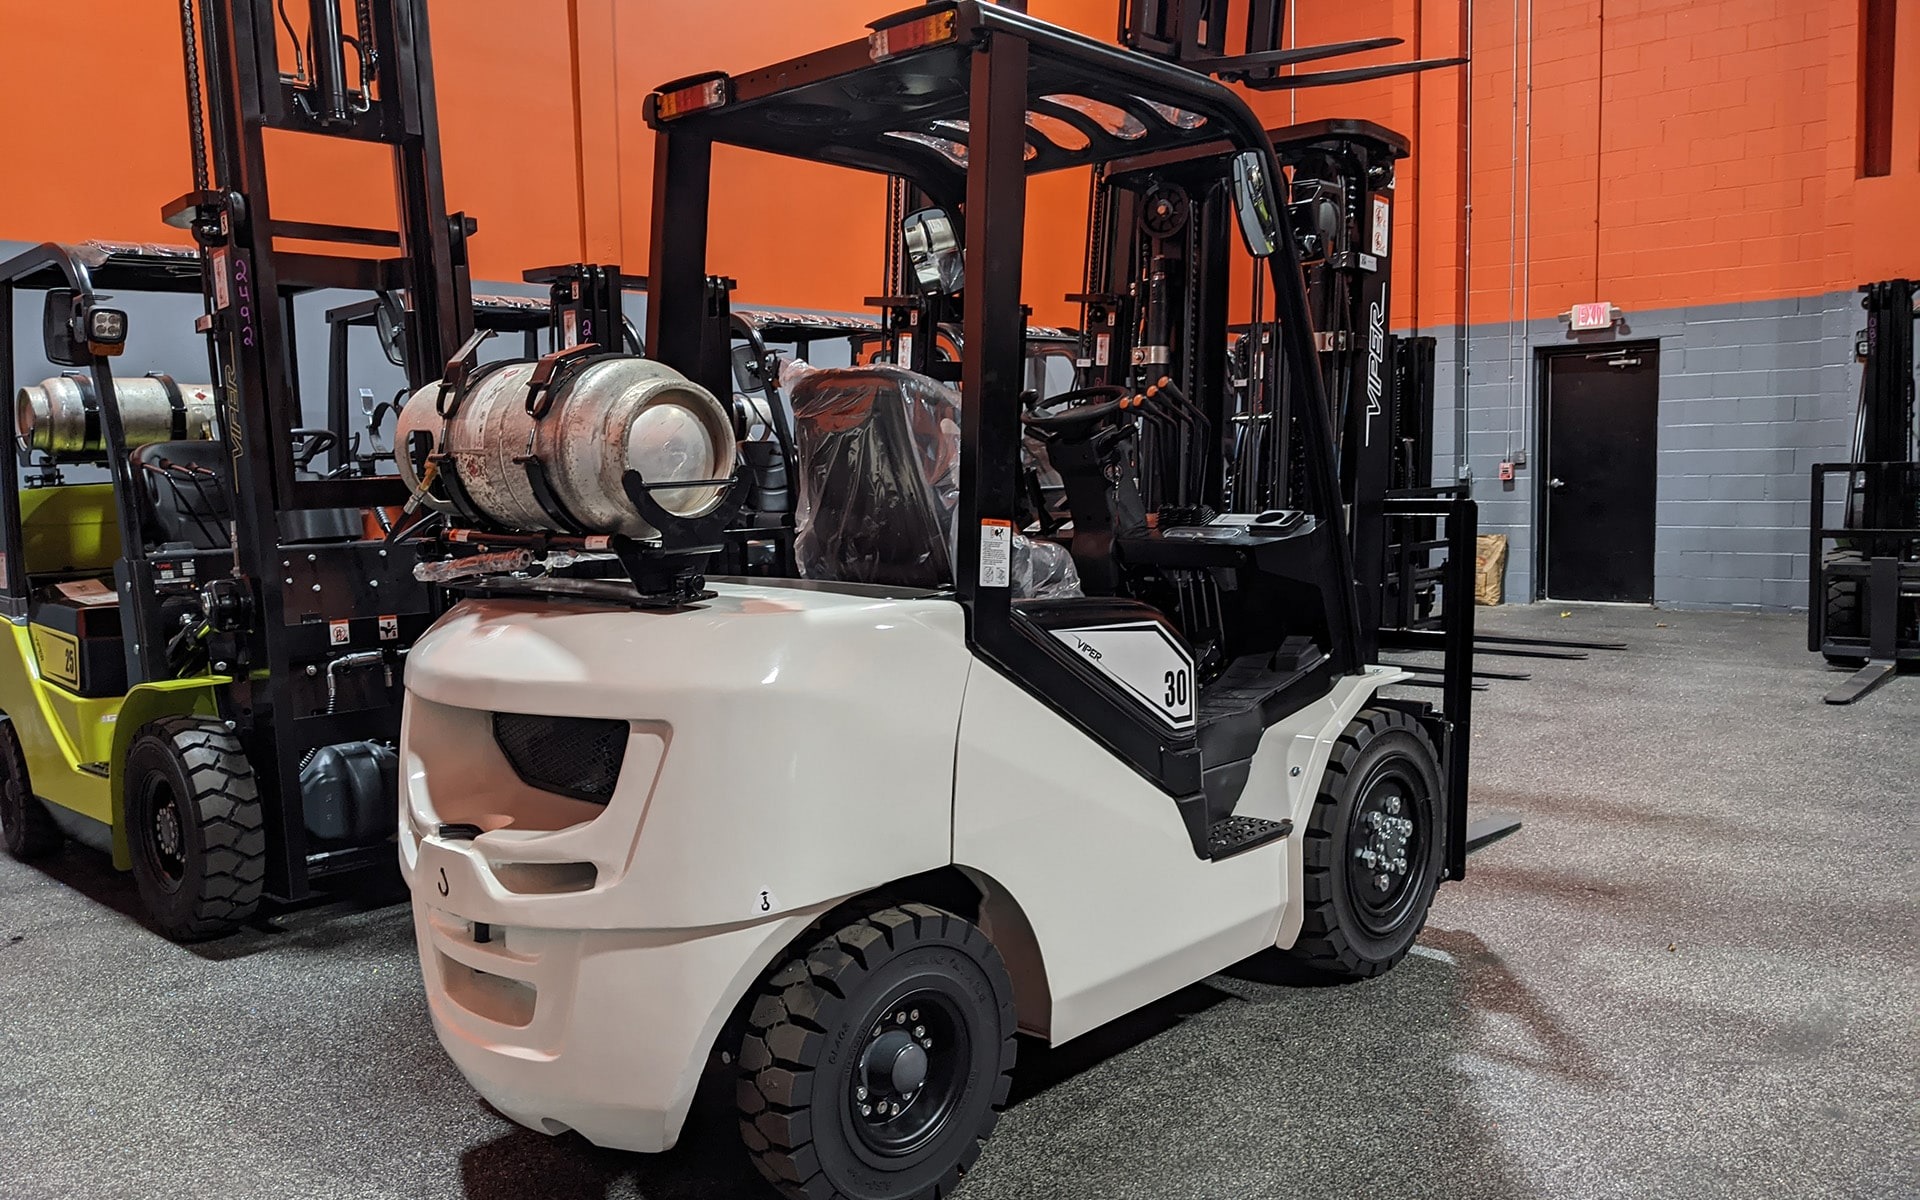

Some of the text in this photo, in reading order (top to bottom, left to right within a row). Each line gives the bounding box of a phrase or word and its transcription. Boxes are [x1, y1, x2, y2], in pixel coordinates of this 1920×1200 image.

[235, 259, 254, 347] 2492
[1578, 304, 1607, 326] EXIT
[1365, 282, 1386, 447] VIPER
[224, 332, 244, 494] VIPER
[64, 648, 74, 674] 25
[1075, 638, 1103, 662] VIPER
[1164, 669, 1187, 708] 30
